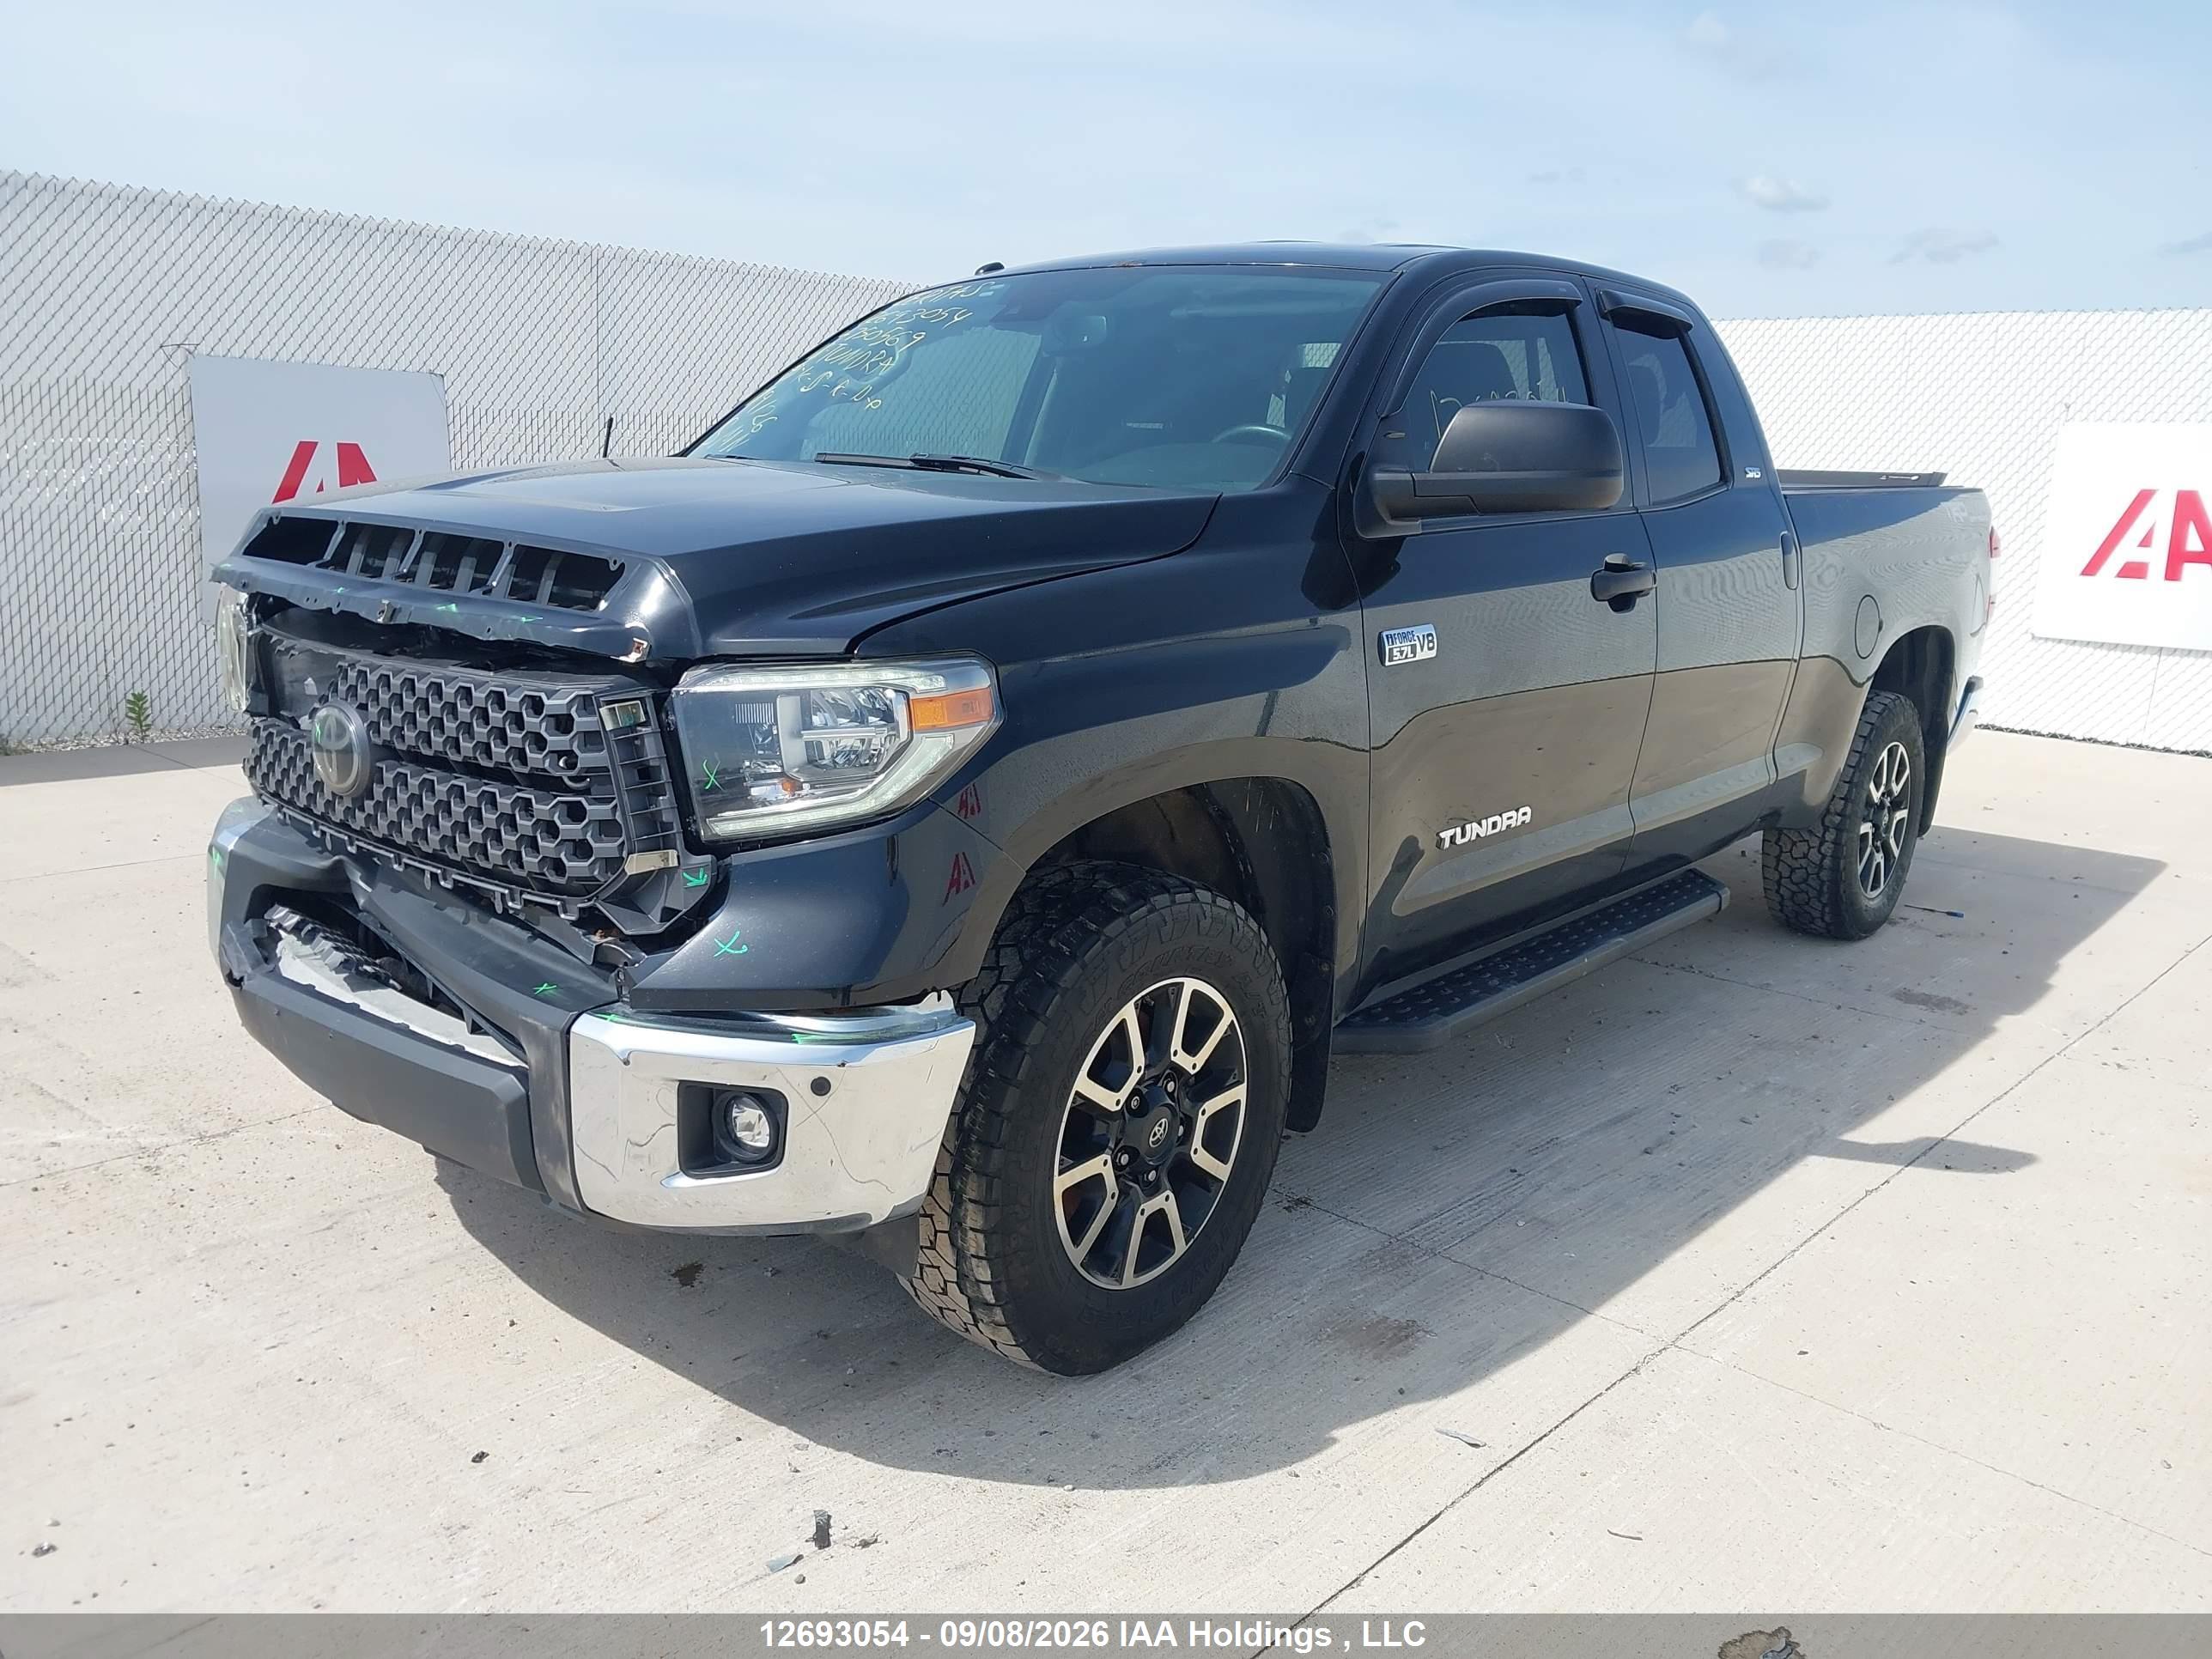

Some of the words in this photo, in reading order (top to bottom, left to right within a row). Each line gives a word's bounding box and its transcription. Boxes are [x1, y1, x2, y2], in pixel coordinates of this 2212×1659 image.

[1392, 644, 1415, 661] 5.7L
[1416, 632, 1436, 653] V8
[1437, 805, 1533, 851] TUNDRA
